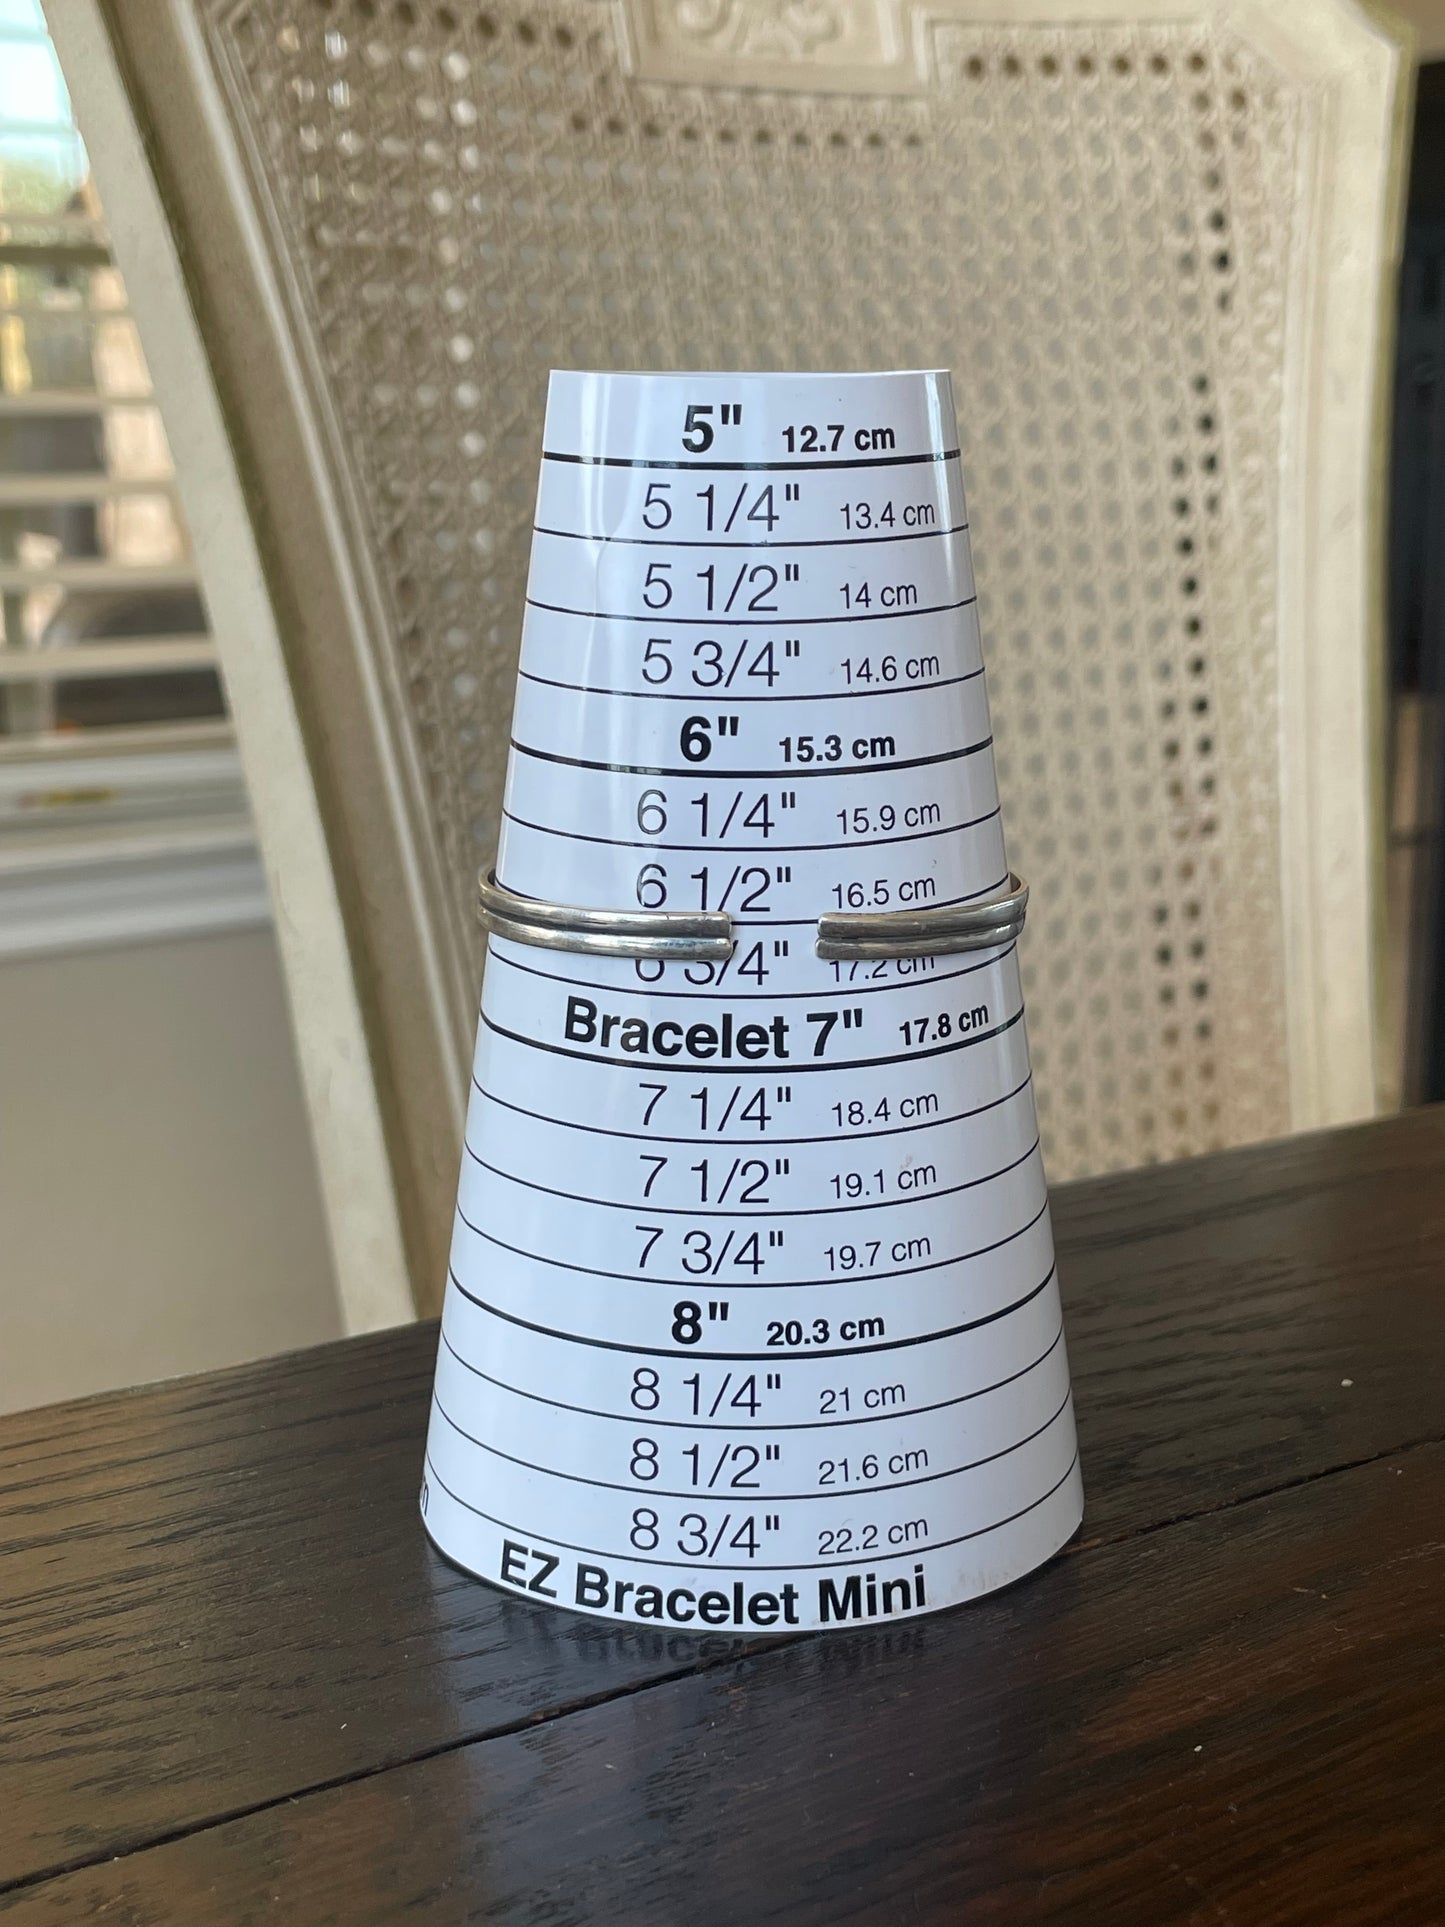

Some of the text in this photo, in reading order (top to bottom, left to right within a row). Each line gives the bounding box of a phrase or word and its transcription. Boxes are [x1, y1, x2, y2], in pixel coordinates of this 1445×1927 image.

[682, 404, 895, 453] 5" 12.7 cm
[642, 483, 935, 532] 5 1/4" 13.4 cm
[643, 563, 917, 612] 5 1/2" 14 cm
[642, 638, 940, 688] 5 3/4" 14.6 cm
[680, 716, 896, 762] 6" 15.3 cm
[637, 789, 941, 838] 6 1/4" 15.9 cm
[637, 864, 937, 912] 6 1/2" 16.5 cm
[564, 996, 989, 1058] Bracelet 7" 17.8 cm
[639, 1083, 940, 1132] 7 1/4" 18.4 cm
[640, 1155, 937, 1204] 7 1/2" 19.1 cm
[635, 1225, 933, 1275] 7 3/4" 19.7 cm
[672, 1301, 886, 1349] 8" 20.3 cm
[631, 1367, 906, 1417] 8 1/4" 21 cm
[630, 1438, 930, 1488] 8 1/2" 21.6 cm
[630, 1508, 929, 1558] 8 3/4" 22.2 cm
[500, 1539, 927, 1625] EZ Bracelet Mini
